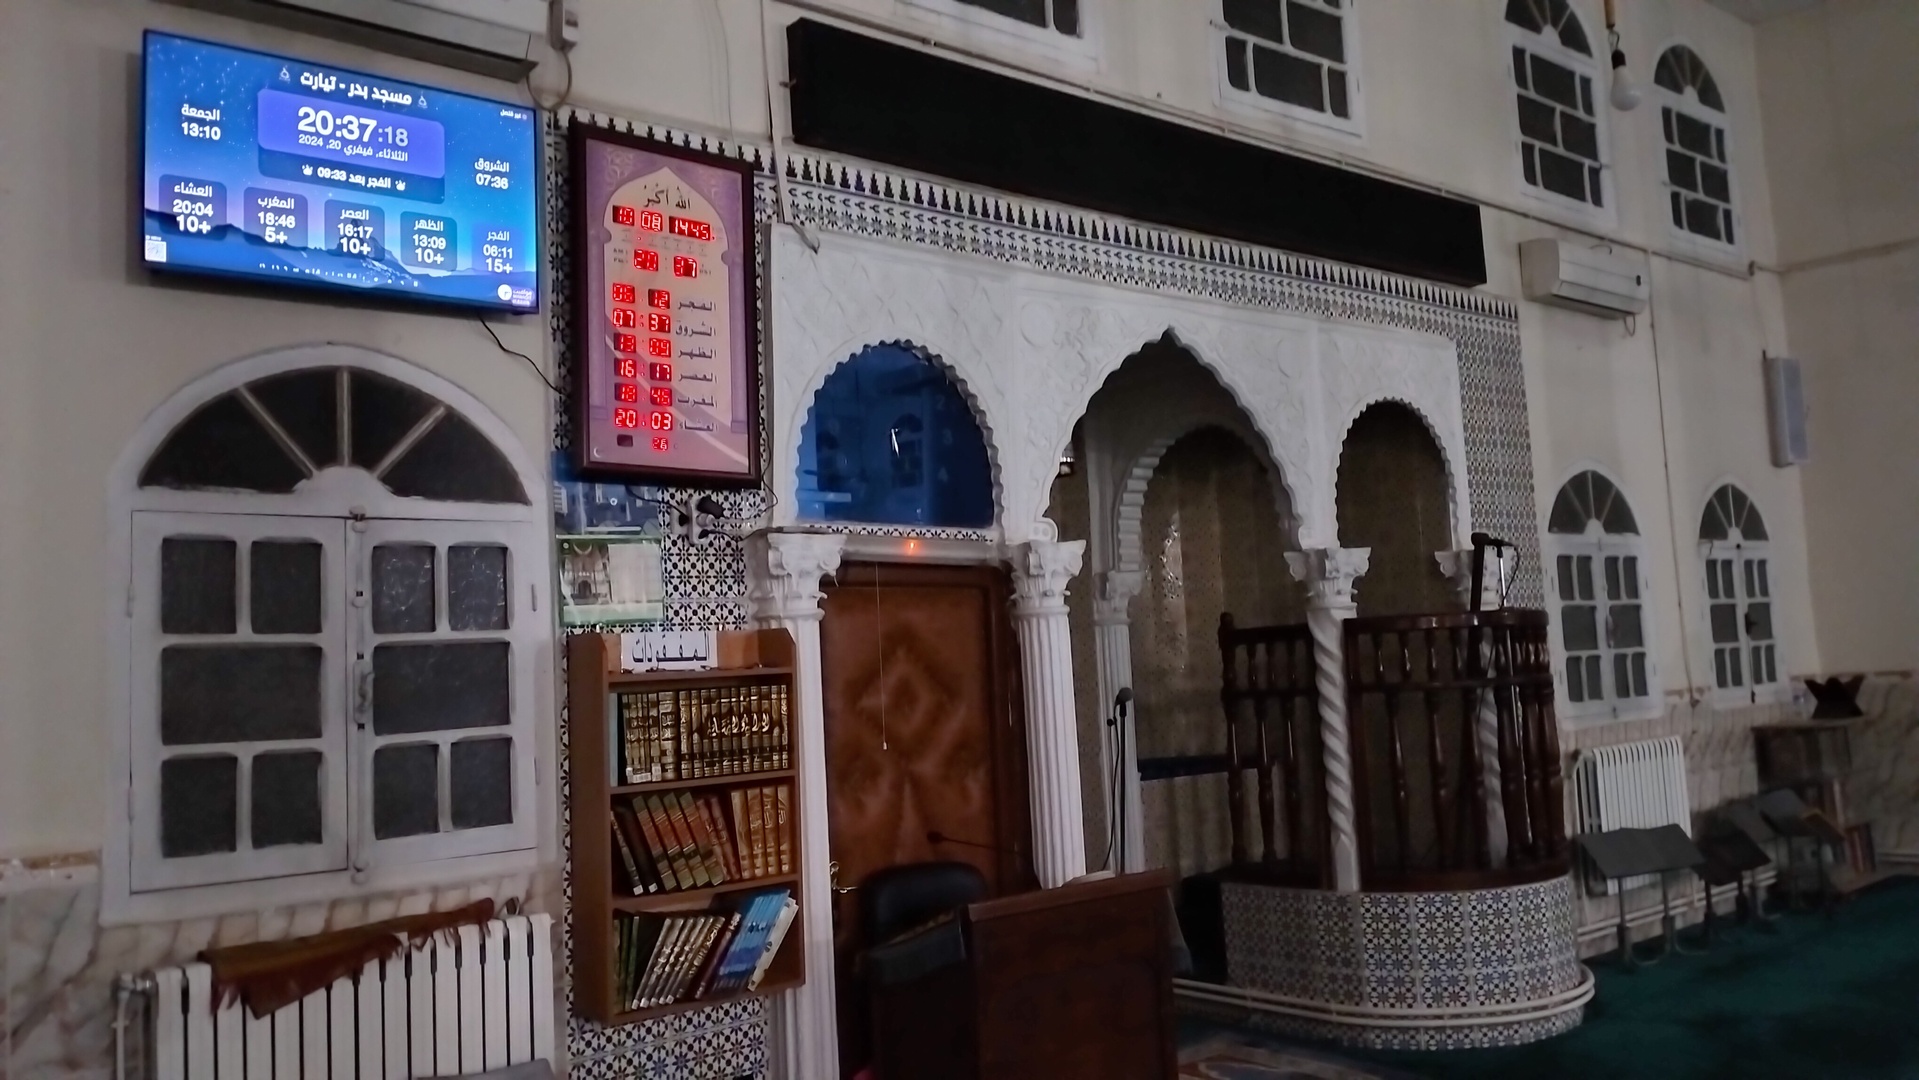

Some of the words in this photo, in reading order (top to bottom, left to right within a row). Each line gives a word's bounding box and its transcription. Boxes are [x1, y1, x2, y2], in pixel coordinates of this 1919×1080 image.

[300, 72, 337, 92] تيارت
[348, 83, 368, 100] بدر
[371, 87, 412, 106] مسجد
[181, 104, 221, 122] الجمعة
[181, 122, 221, 140] 13:10
[298, 134, 323, 147] 2024
[344, 144, 373, 156] فيفري
[474, 157, 510, 173] الشروق
[317, 167, 347, 181] 09:33
[348, 173, 366, 187] بعد
[366, 176, 391, 188] الفجر
[476, 173, 509, 190] 07:36
[174, 182, 213, 198] العشاء
[675, 186, 691, 210] الله
[173, 199, 214, 217] 20:04
[257, 196, 295, 210] المغرب
[257, 211, 296, 229] 18:46
[340, 208, 370, 221] العصر
[337, 222, 373, 240] 16:17
[413, 219, 444, 232] الظهر
[618, 206, 634, 226] 10
[641, 210, 662, 232] 08
[673, 218, 709, 240] 1445
[412, 233, 447, 250] 13:09
[486, 230, 510, 242] الفجر
[482, 244, 513, 260] 06:11
[678, 300, 716, 312] الفجر
[676, 320, 716, 337] الشروق
[678, 346, 717, 360] الظهر
[678, 373, 718, 383] العصر
[679, 418, 718, 432] العشاء
[652, 437, 668, 452] 26
[632, 630, 710, 668] المفقودات
